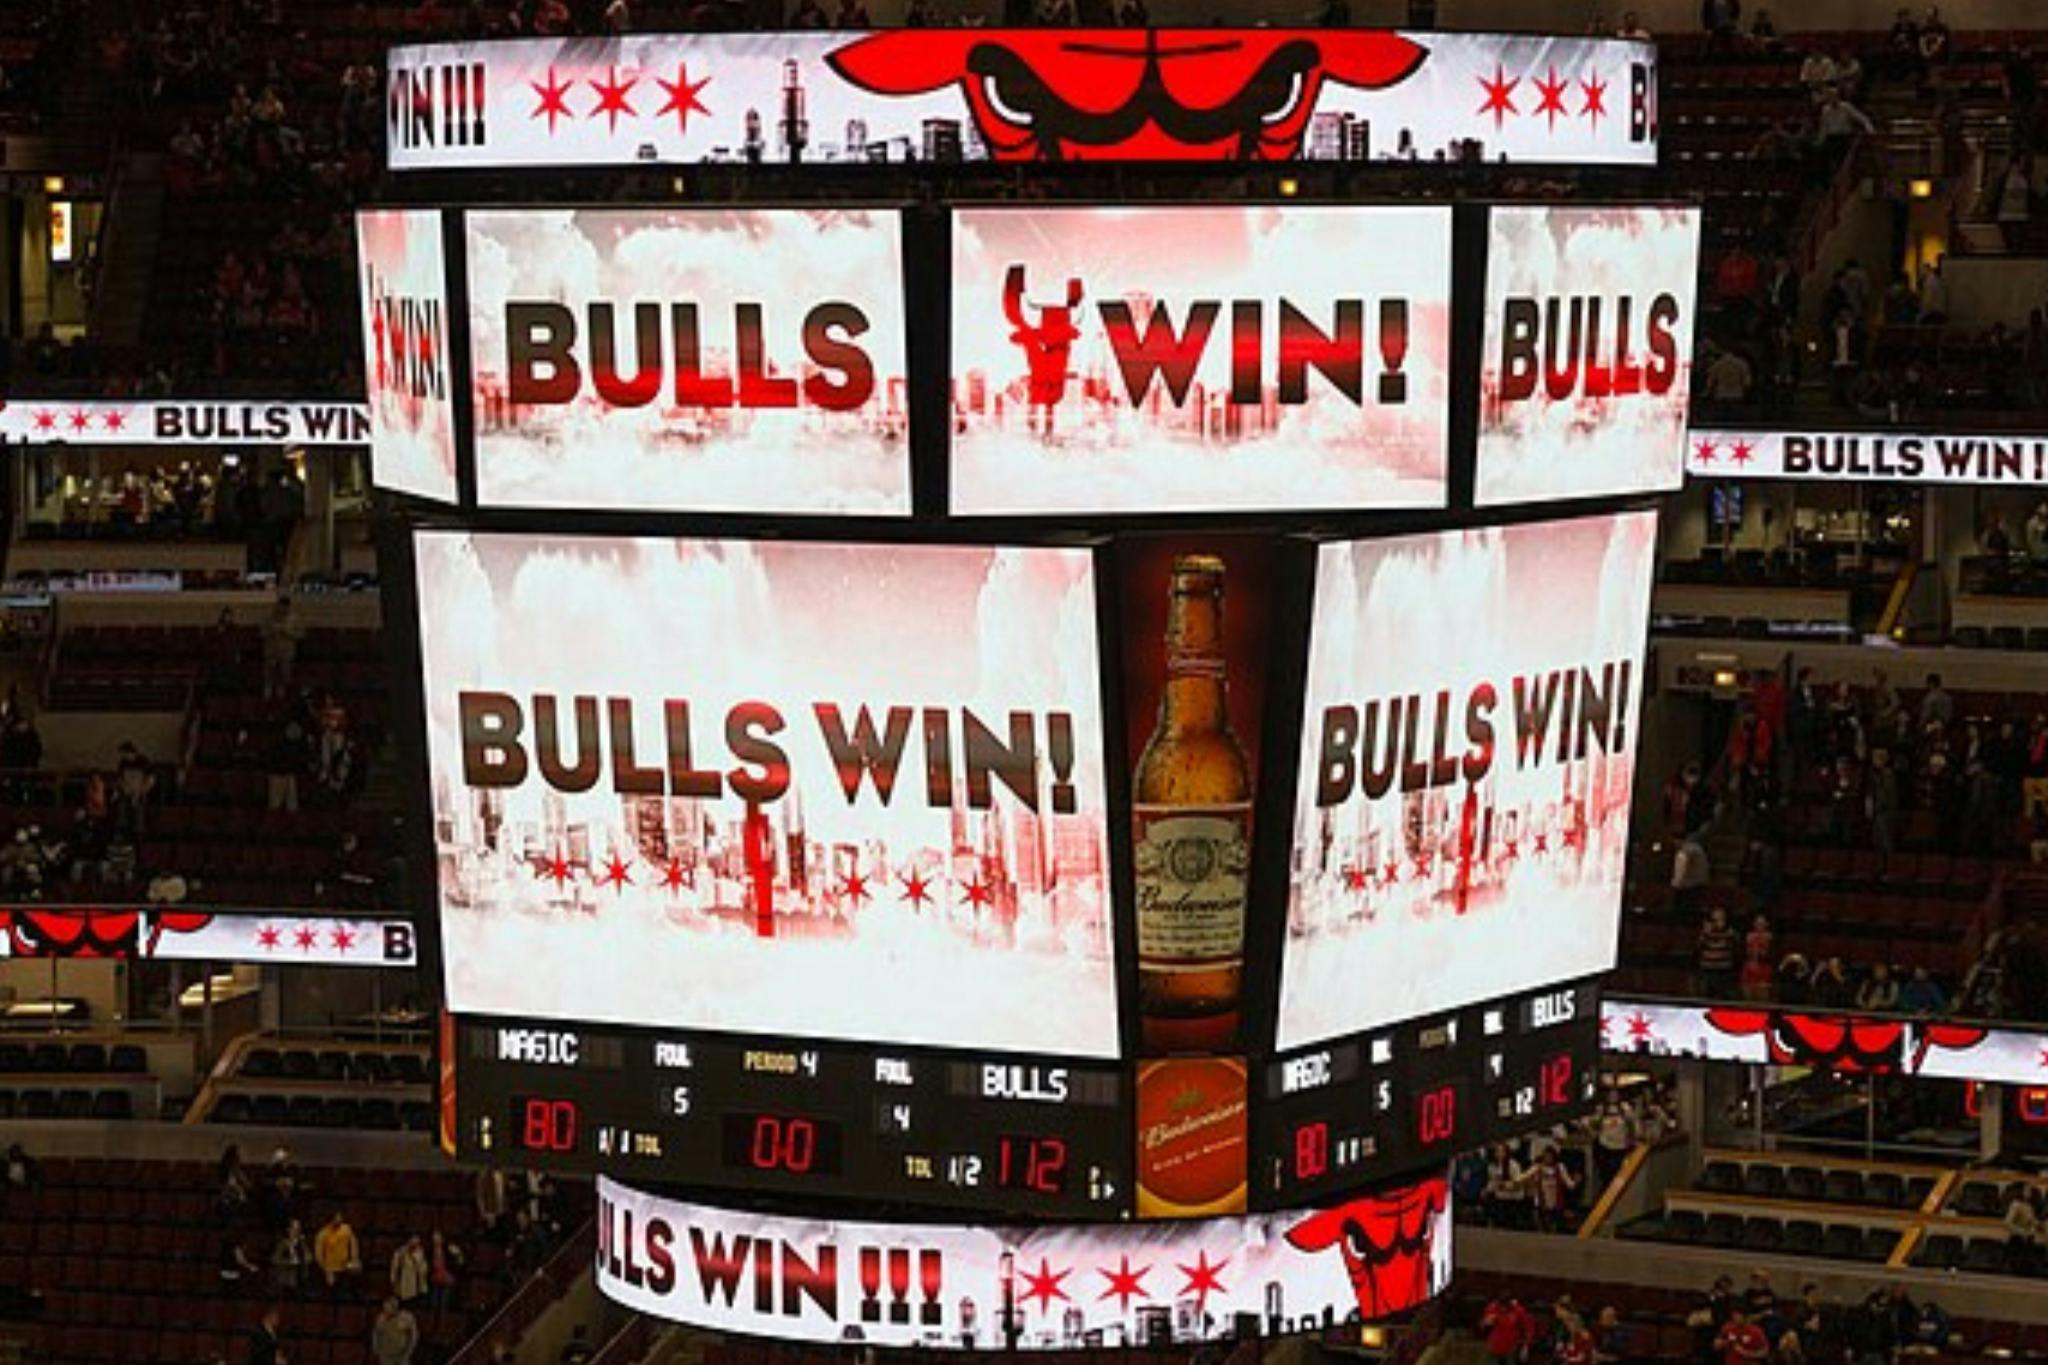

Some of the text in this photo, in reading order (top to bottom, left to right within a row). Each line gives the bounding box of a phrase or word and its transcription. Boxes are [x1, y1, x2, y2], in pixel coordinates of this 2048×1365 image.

[505, 301, 875, 411] BULLS
[1097, 298, 1410, 408] WIN!
[1501, 293, 1679, 402] BULLS
[154, 405, 291, 440] BULLS
[1782, 435, 1925, 477] BULLS
[458, 690, 1077, 814] BULLS WIN!
[1315, 659, 1632, 808] BULLS WIN!
[383, 925, 413, 960] B
[498, 1027, 579, 1065] MAGIC
[800, 1051, 818, 1077] 4
[673, 1086, 690, 1115] 5
[982, 1063, 1068, 1102] BULLS
[523, 1099, 577, 1150] 80
[893, 1104, 910, 1131] 4
[689, 1226, 838, 1323] WIN
